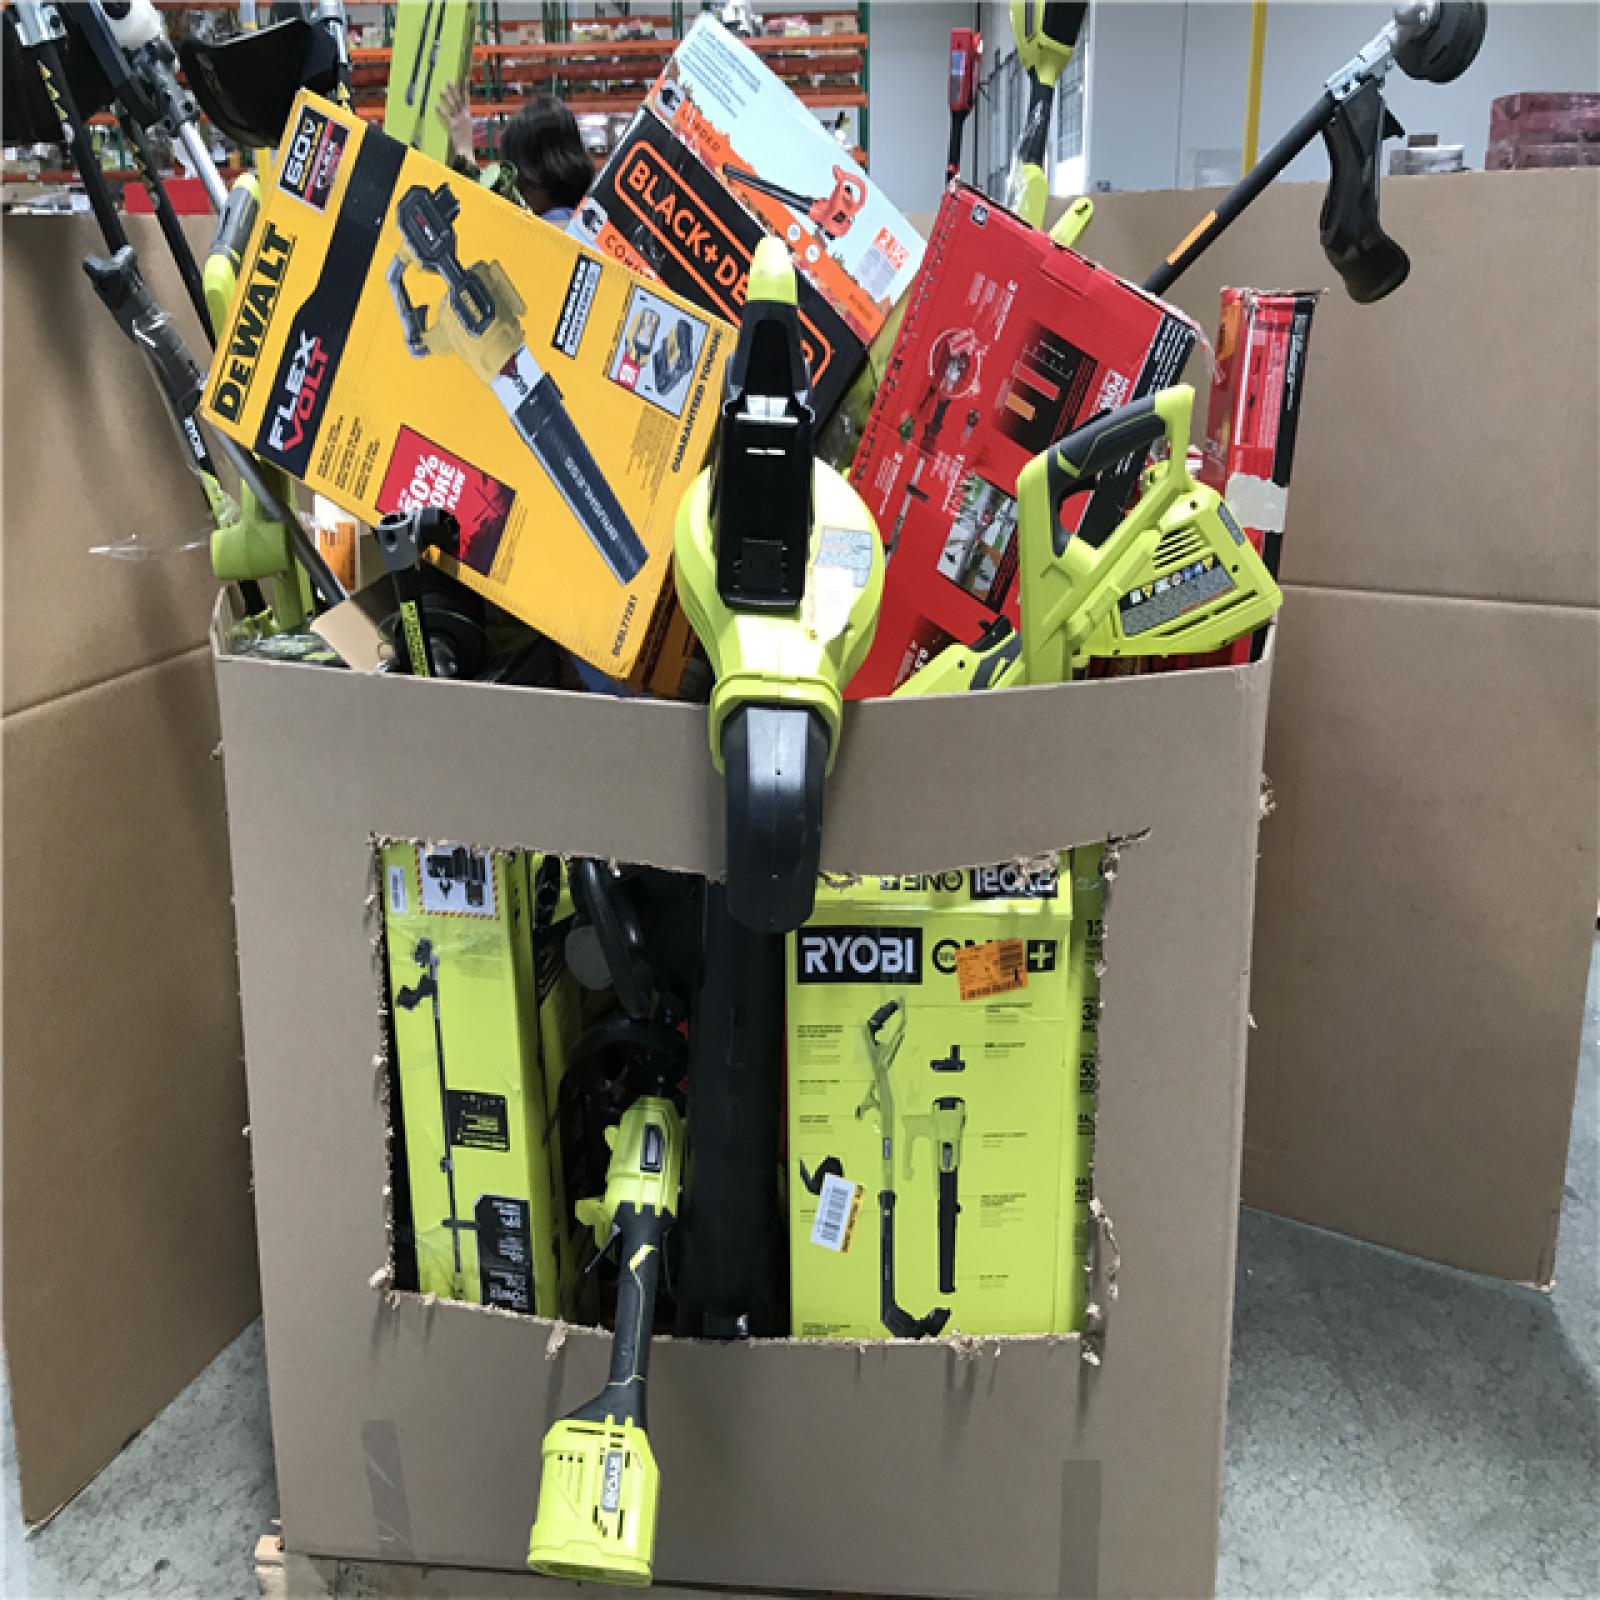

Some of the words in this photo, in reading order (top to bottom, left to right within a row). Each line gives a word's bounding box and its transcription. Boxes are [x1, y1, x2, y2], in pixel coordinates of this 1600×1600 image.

[211, 222, 292, 422] DEWALT
[267, 329, 318, 450] FLEX
[282, 336, 329, 451] VOLT
[429, 462, 456, 509] ORE
[802, 937, 914, 974] RYOBI
